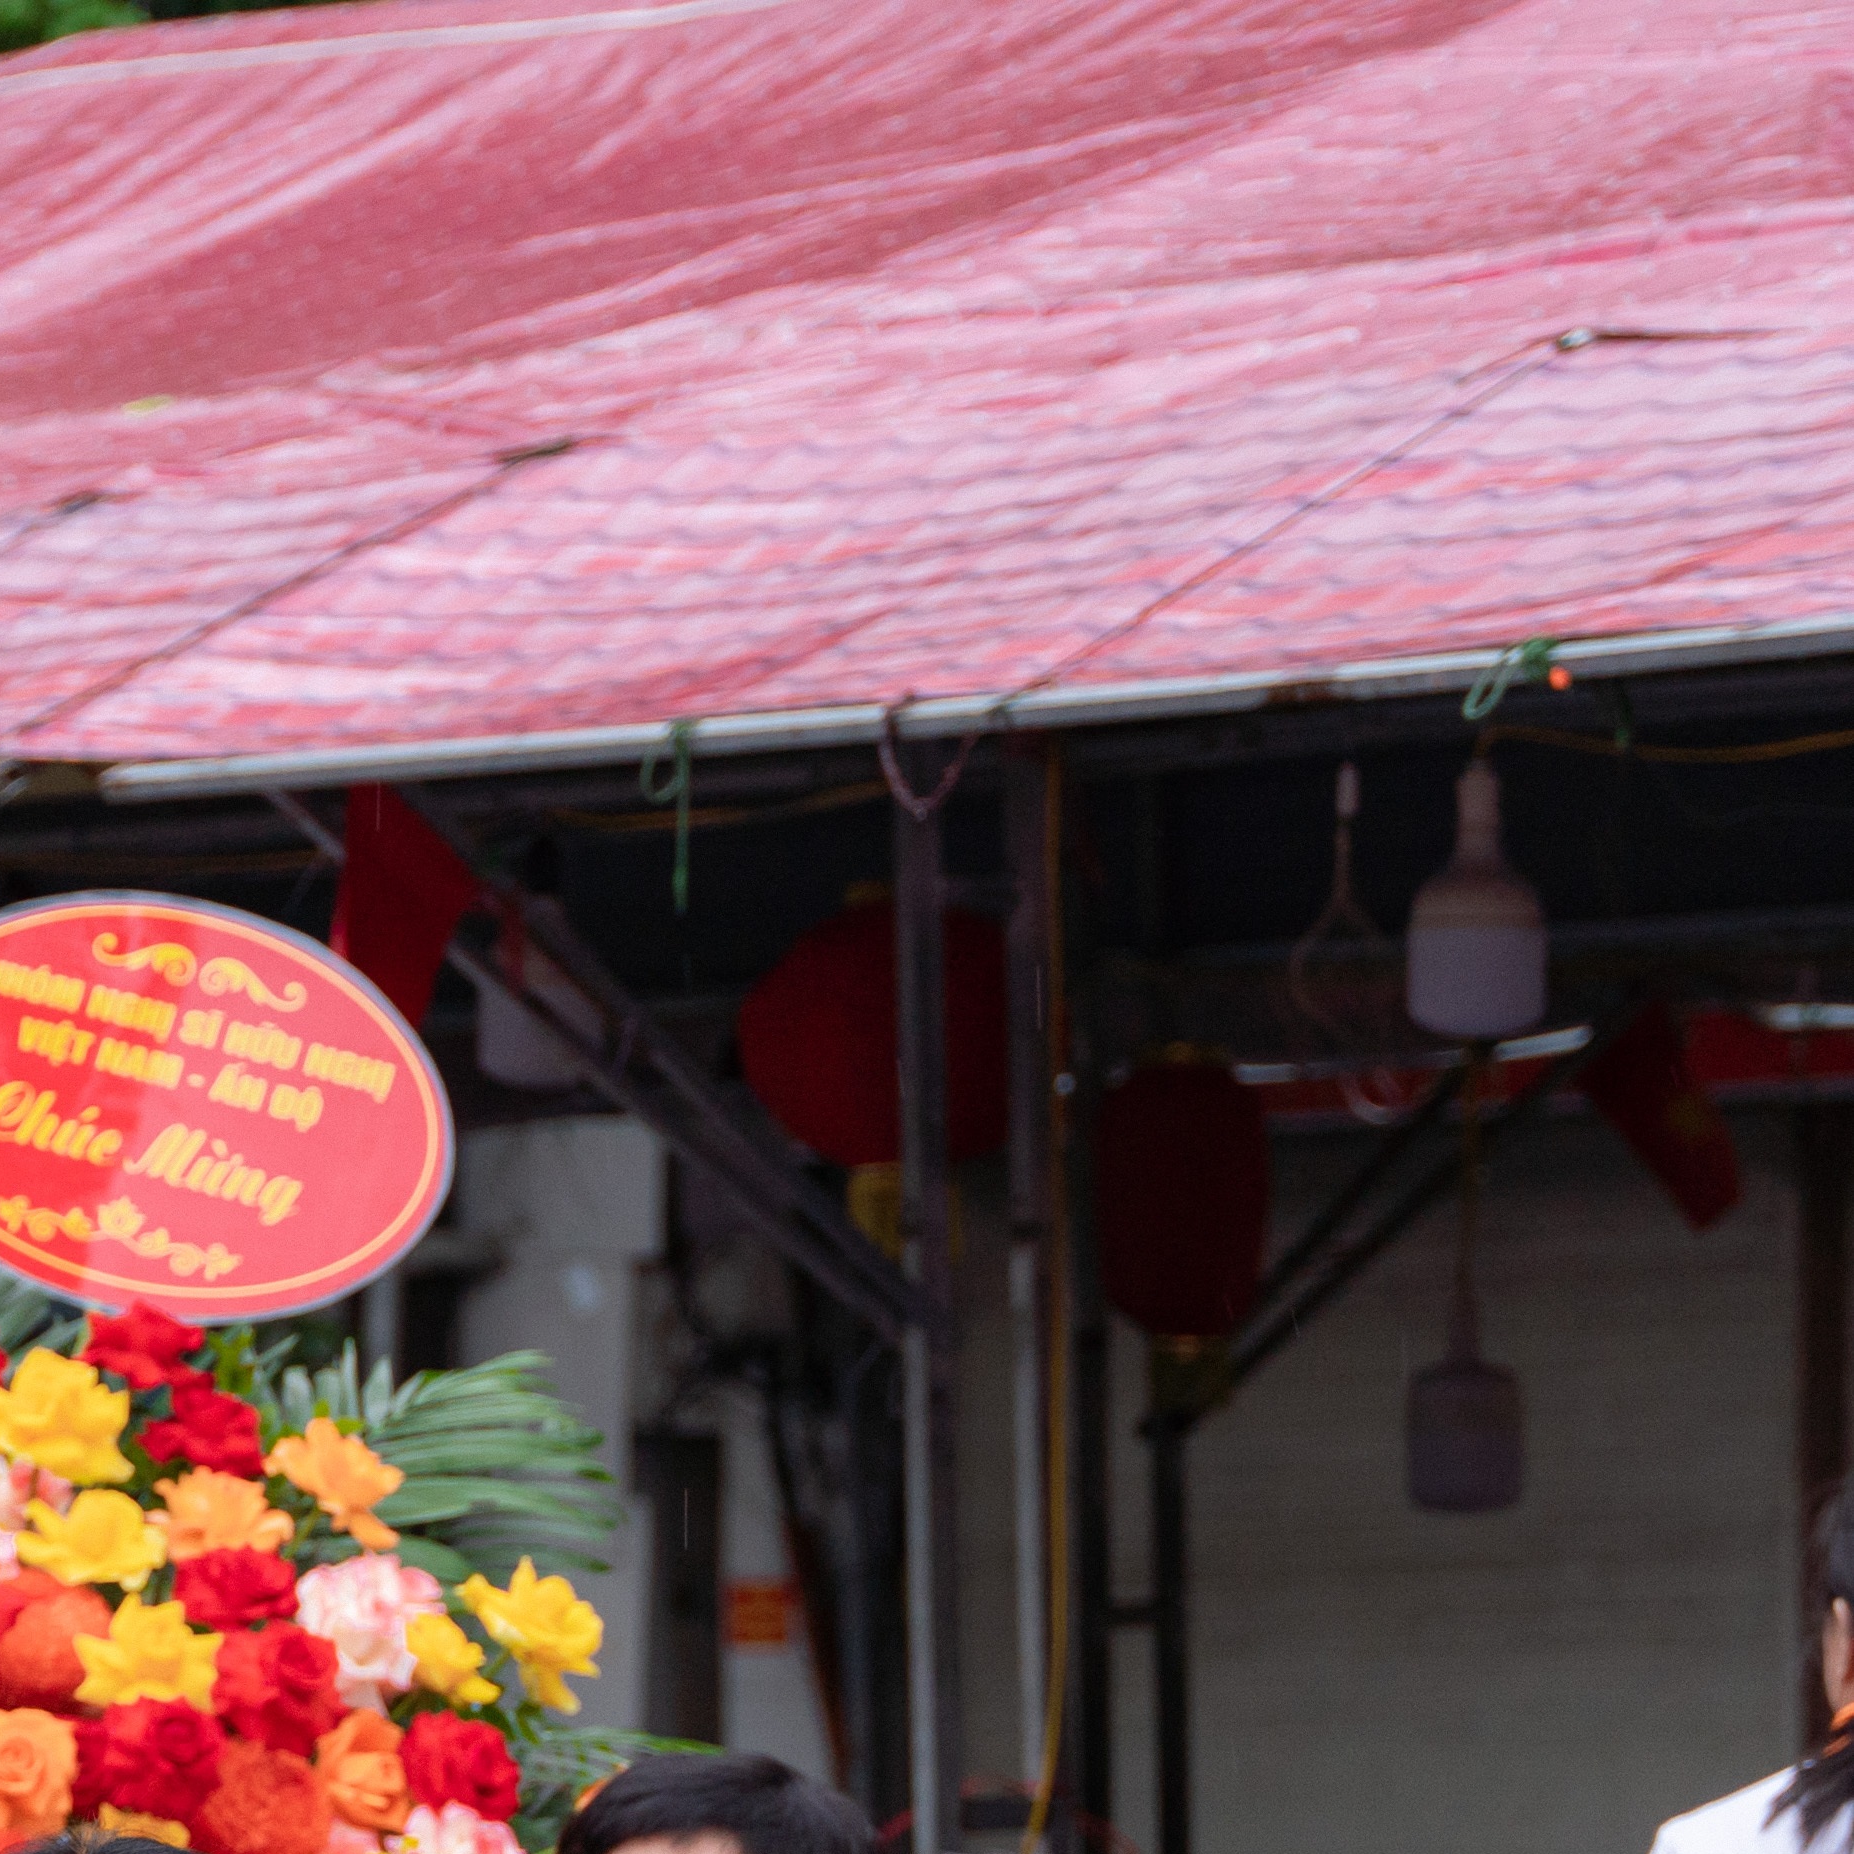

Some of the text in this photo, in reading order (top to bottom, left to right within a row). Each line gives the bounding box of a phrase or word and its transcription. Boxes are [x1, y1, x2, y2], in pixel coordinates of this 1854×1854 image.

[18, 1015, 96, 1067] VIỆT
[94, 1037, 185, 1089] NAM
[122, 1123, 304, 1227] Mừng
